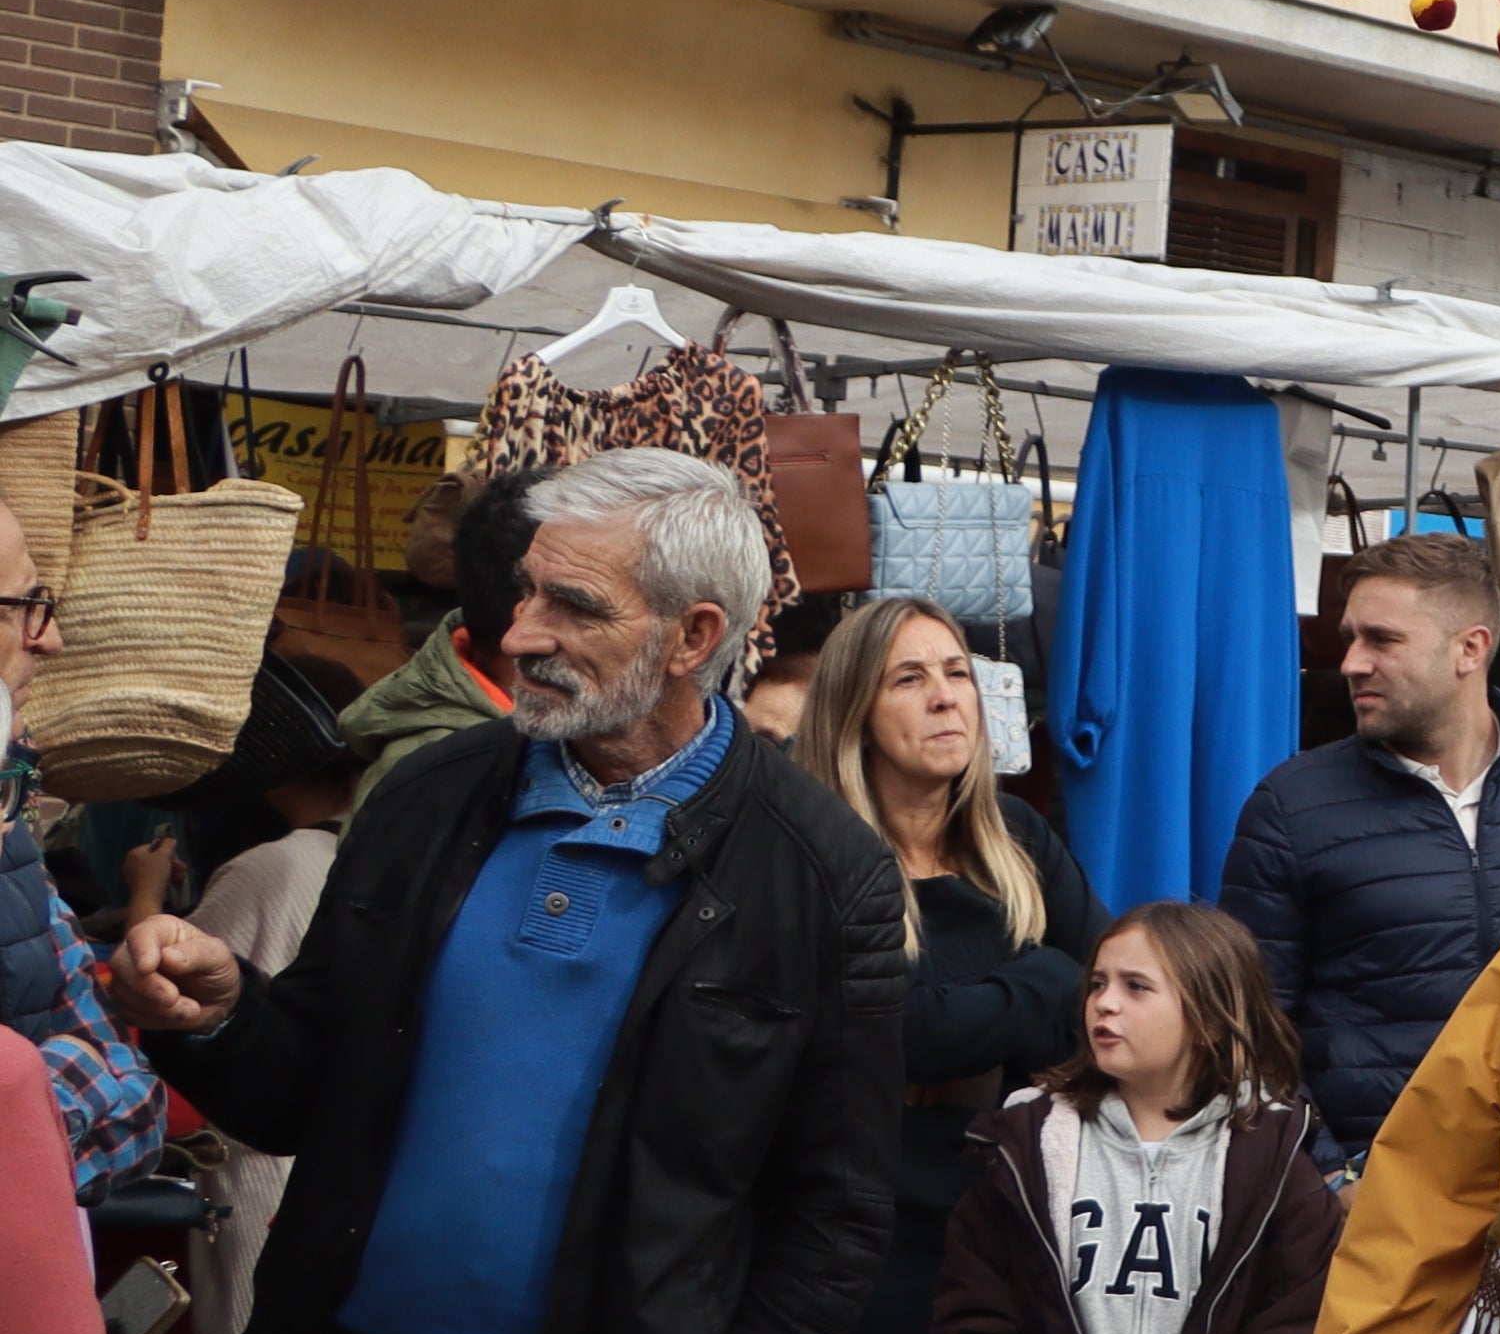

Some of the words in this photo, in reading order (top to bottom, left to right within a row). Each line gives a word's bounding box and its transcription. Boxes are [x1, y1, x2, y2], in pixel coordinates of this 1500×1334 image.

[1055, 140, 1125, 174] CASA
[1046, 212, 1120, 247] MAMI
[364, 431, 445, 468] ma
